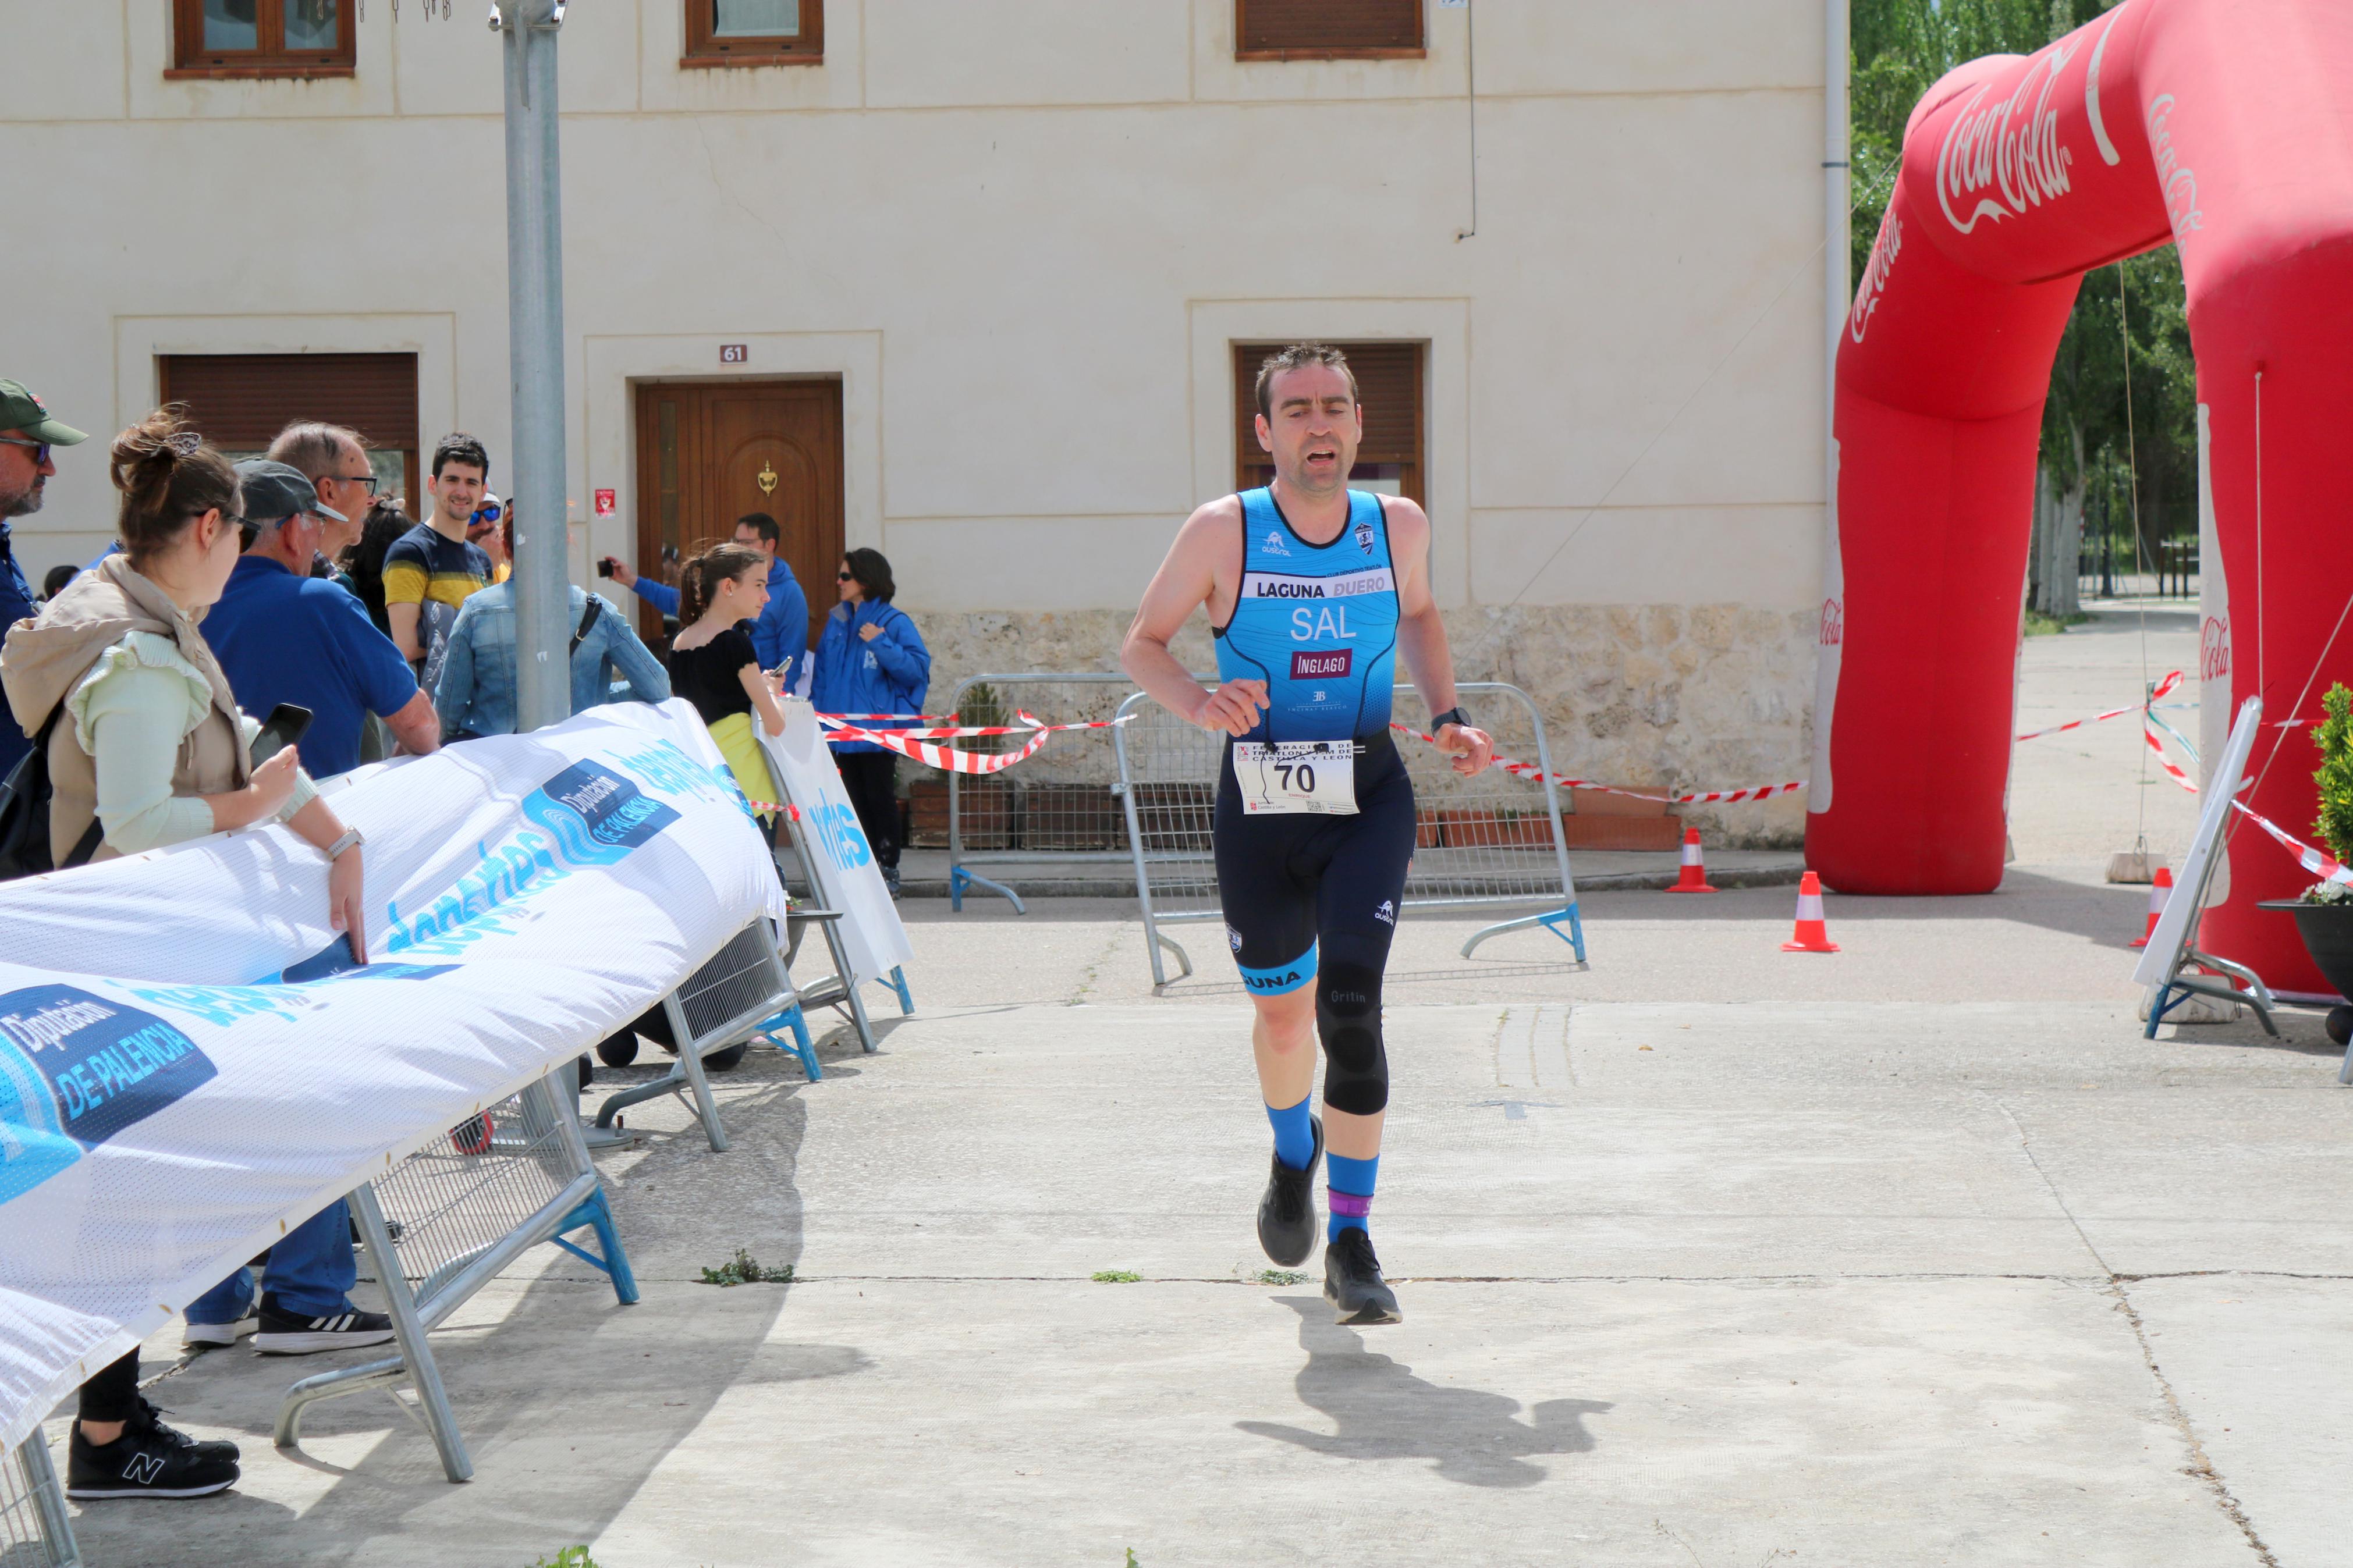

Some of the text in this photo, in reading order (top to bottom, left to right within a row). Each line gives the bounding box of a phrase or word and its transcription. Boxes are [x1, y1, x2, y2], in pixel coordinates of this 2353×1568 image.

[724, 346, 741, 362] 61
[1340, 567, 1364, 576] DEPORTIVO
[1257, 576, 1385, 598] LAGUNA DUERO
[1290, 606, 1357, 641] SAL
[1297, 655, 1345, 674] INGLAGO
[1273, 764, 1315, 793] 70
[606, 795, 664, 835] PALENCIA
[1331, 990, 1366, 1004] Gritin
[56, 1022, 196, 1121] DE PALENCIA
[122, 1452, 166, 1484] N
